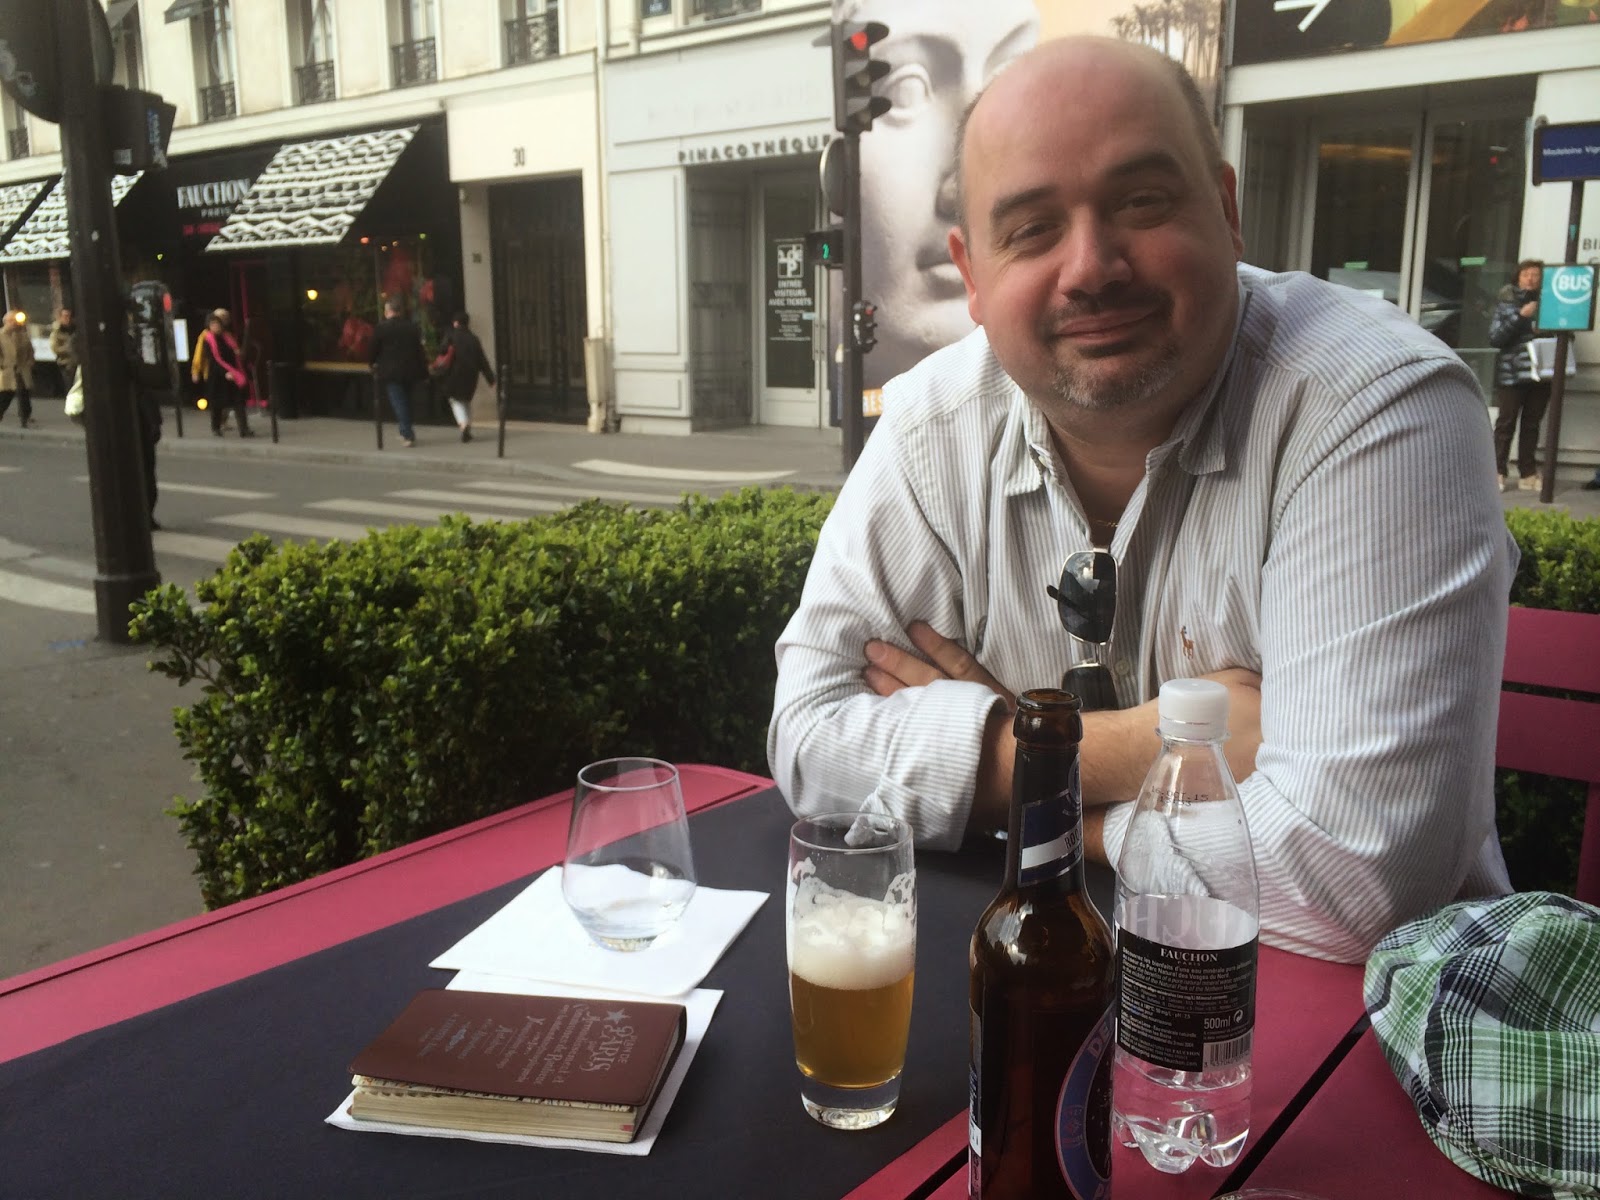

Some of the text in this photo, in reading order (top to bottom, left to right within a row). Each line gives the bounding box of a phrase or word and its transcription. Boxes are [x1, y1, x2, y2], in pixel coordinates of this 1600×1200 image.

[513, 147, 525, 166] 30
[177, 178, 251, 209] FAUCHON
[1558, 275, 1591, 291] BUS
[1160, 948, 1218, 962] FAUCHON
[1190, 973, 1208, 981] Vosges
[1204, 1016, 1230, 1029] 500ml
[577, 1024, 636, 1073] PARIS
